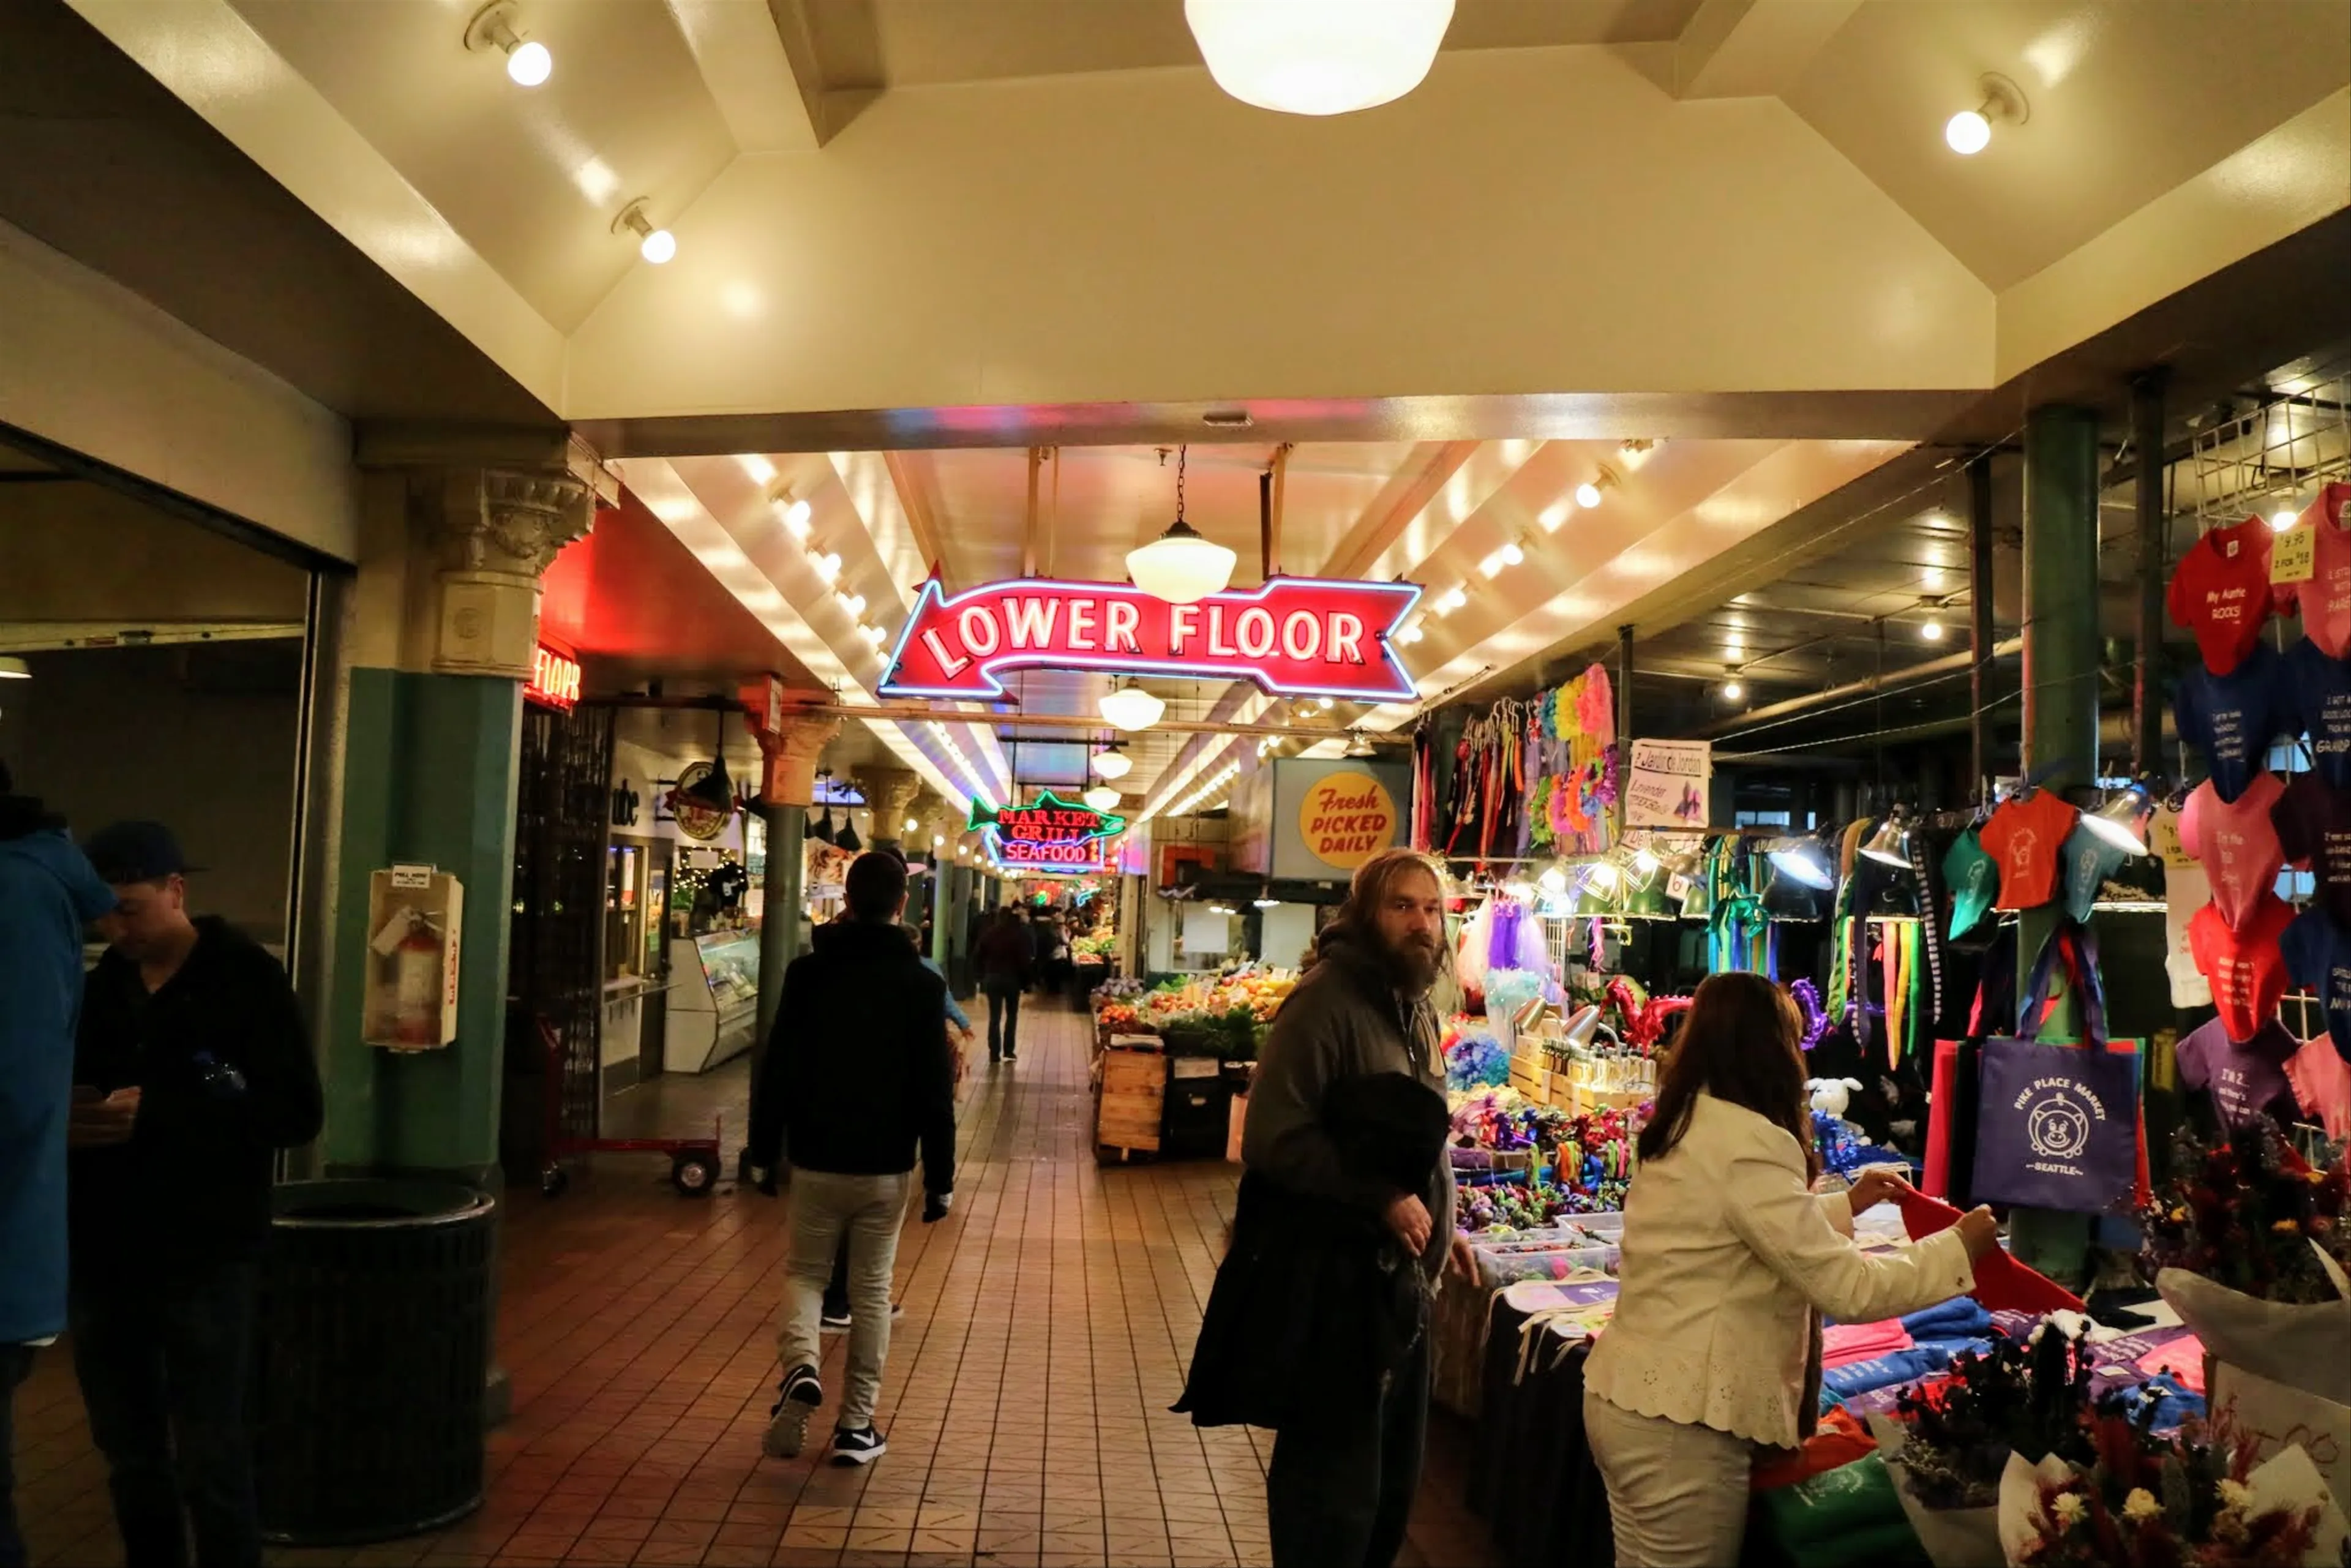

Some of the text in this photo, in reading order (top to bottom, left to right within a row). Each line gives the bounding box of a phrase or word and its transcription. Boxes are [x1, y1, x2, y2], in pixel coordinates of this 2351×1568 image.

[920, 597, 1366, 679] LOWER FLOOR
[1319, 785, 1379, 813] Fresh
[998, 809, 1100, 827] MARKET
[1310, 814, 1387, 835] PICKED
[1006, 844, 1086, 862] SEAFOOD
[1319, 835, 1378, 853] DAILY
[2014, 1078, 2106, 1121] PIKE PLACE MARKET
